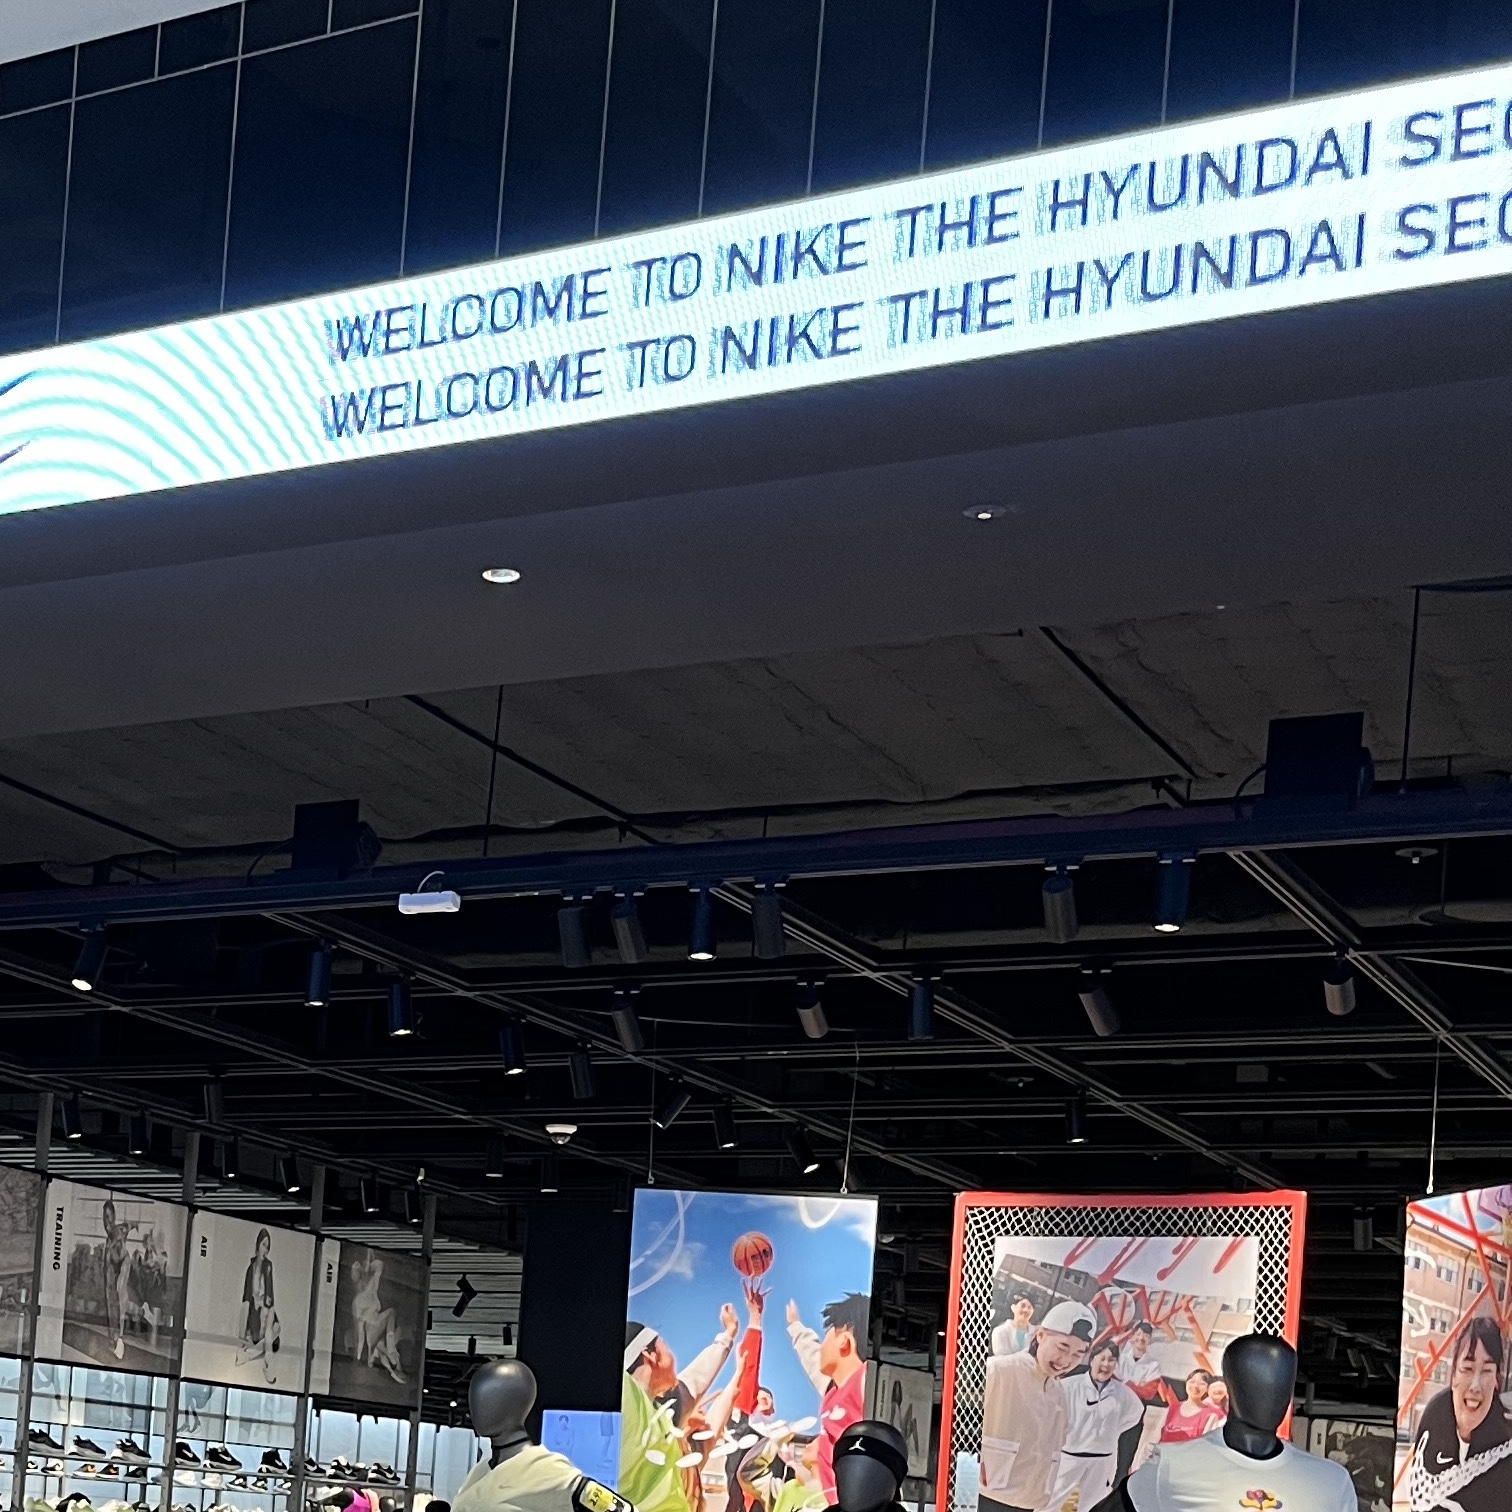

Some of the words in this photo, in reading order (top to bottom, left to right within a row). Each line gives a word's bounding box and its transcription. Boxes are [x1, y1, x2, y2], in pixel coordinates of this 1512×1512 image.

[331, 266, 612, 362] WELCOME
[632, 251, 703, 307] TO
[725, 216, 871, 292] NIKE
[896, 186, 1024, 259] THE
[1049, 120, 1373, 233] HYUNDAI
[1399, 97, 1512, 168] SE
[326, 347, 606, 440] WELCOME
[625, 333, 697, 389] TO
[719, 302, 863, 375] NIKE
[890, 274, 1016, 344] THE
[1043, 213, 1366, 319] HYUNDAI
[52, 1206, 64, 1271] TRAINING
[200, 1235, 208, 1258] AIR
